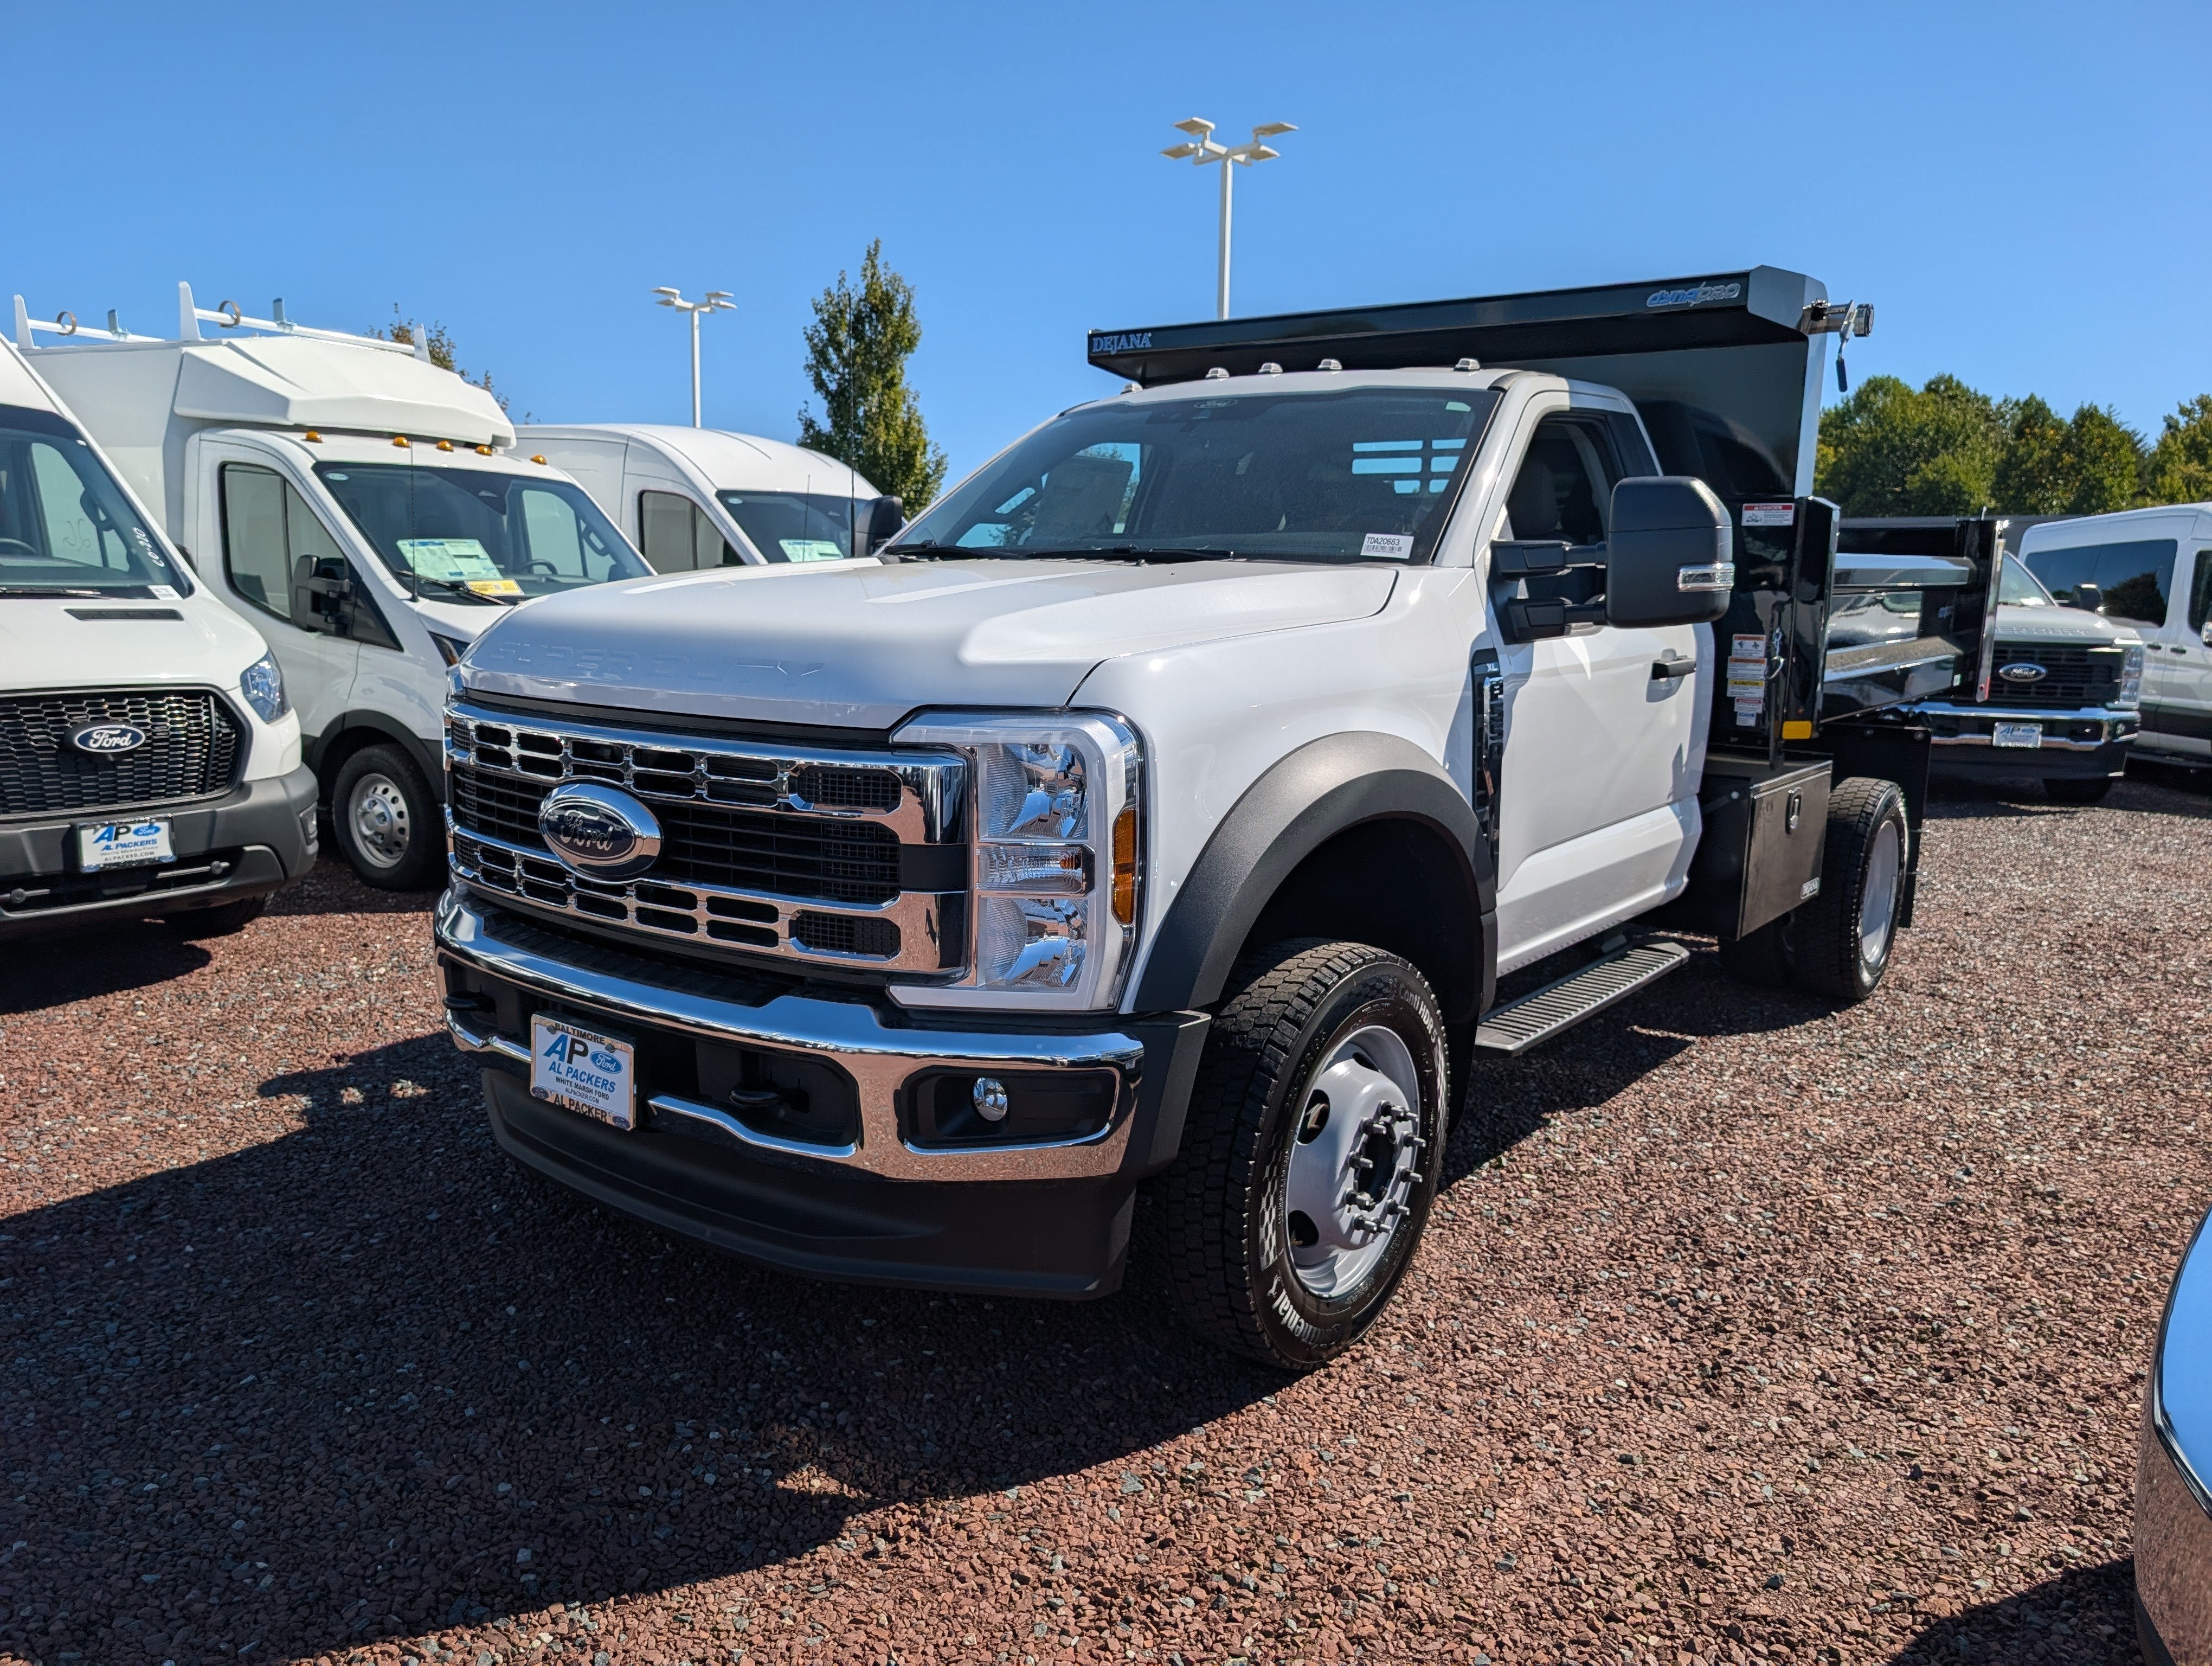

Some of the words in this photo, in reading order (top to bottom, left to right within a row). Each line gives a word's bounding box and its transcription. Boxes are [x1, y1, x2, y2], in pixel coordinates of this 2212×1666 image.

[1092, 332, 1152, 355] DEJANA
[1367, 537, 1400, 546] TDA20663
[1486, 662, 1499, 672] XL
[89, 729, 132, 748] Ford
[93, 825, 132, 844] AP
[560, 809, 613, 851] Ford
[115, 838, 158, 850] PACKERS
[555, 1022, 605, 1045] BALTIMORE
[543, 1034, 589, 1065] AP
[596, 1053, 616, 1072] Ford
[549, 1061, 562, 1075] AL
[566, 1066, 616, 1093] PACKERS
[555, 1076, 573, 1087] WHITE
[574, 1081, 593, 1094] MARSH
[595, 1090, 609, 1100] FORD
[565, 1087, 600, 1104] ALPACKER.COM
[554, 1093, 566, 1107] AL
[569, 1099, 607, 1123] PACKER
[1272, 1289, 1340, 1346] Ctinental
